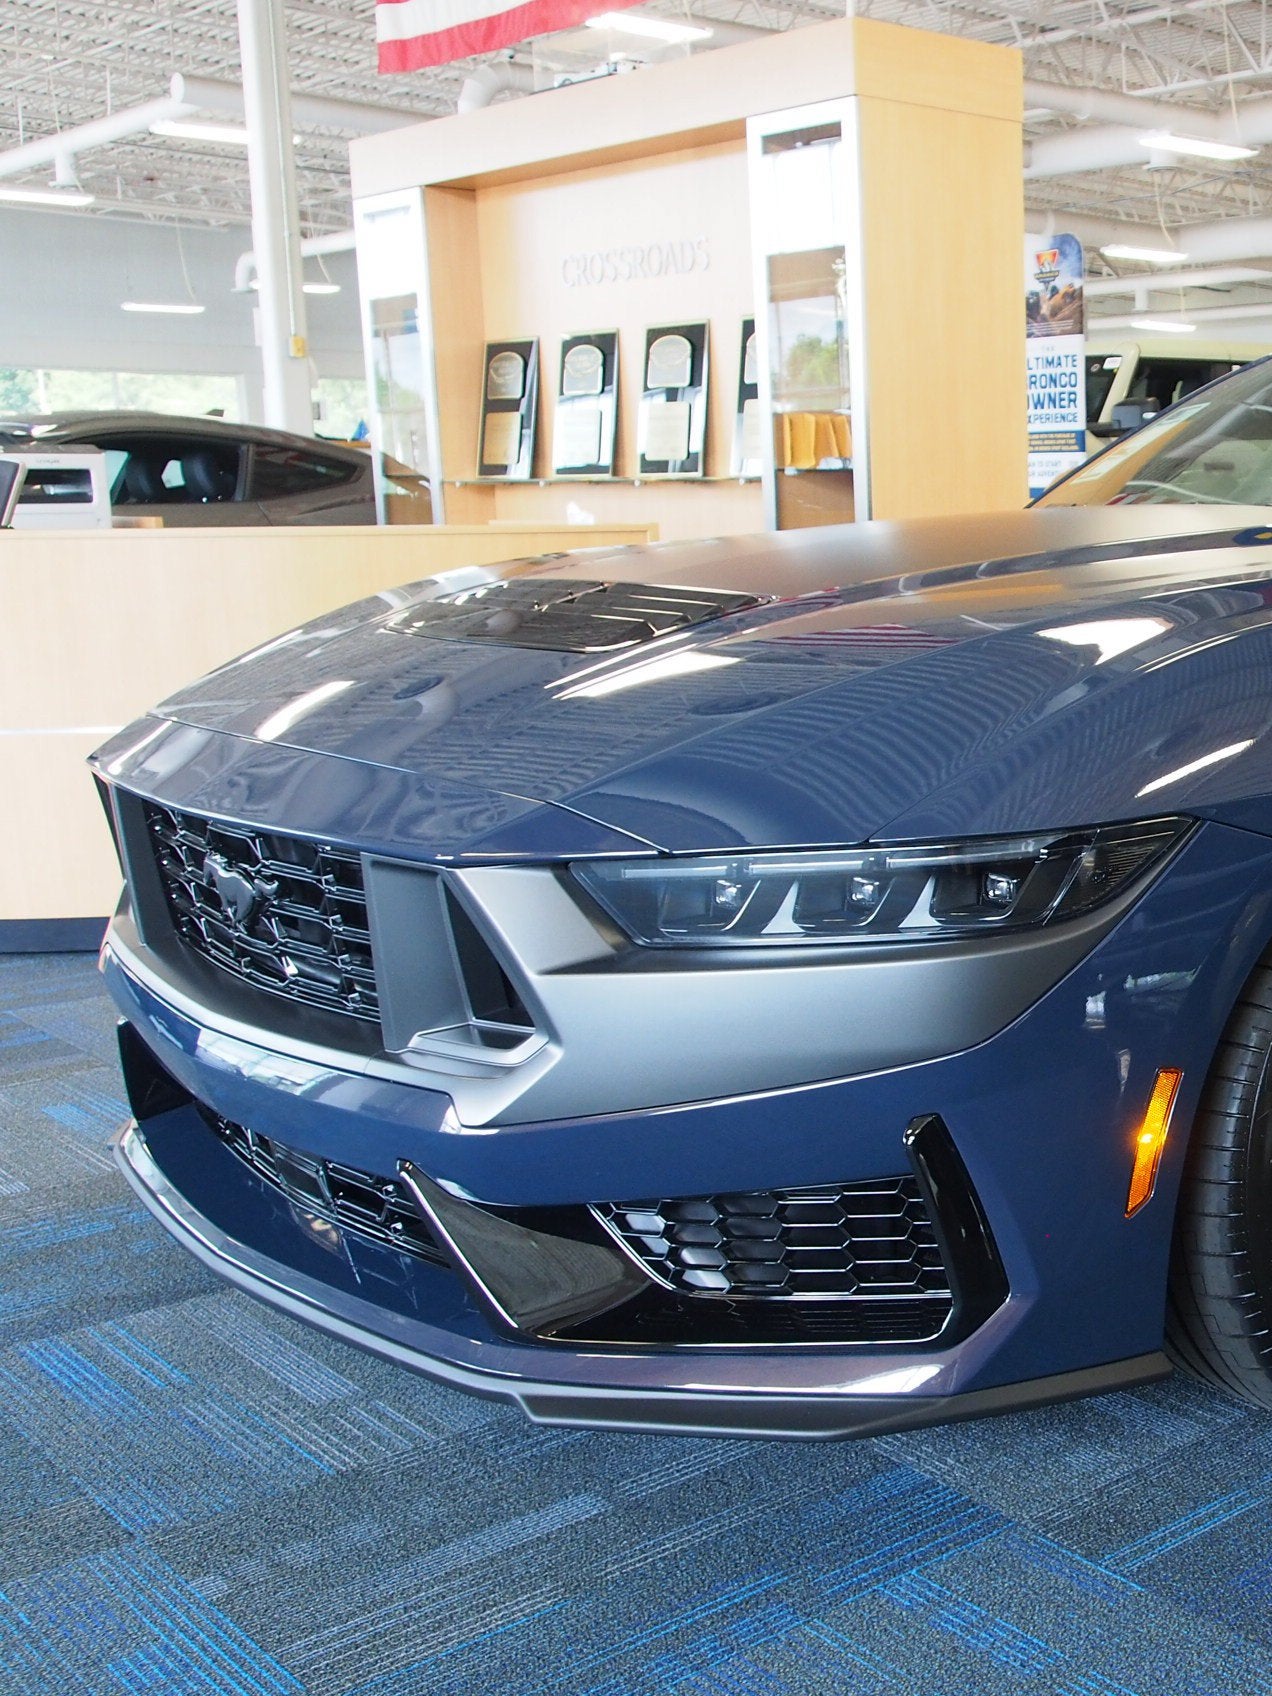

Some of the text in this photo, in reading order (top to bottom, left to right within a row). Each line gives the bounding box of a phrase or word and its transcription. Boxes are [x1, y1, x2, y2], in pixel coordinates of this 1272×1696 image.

[561, 237, 711, 287] CROSSROADS
[1027, 354, 1078, 370] LTIMATE
[1028, 372, 1078, 389] RONCO
[1027, 391, 1078, 410] WNER
